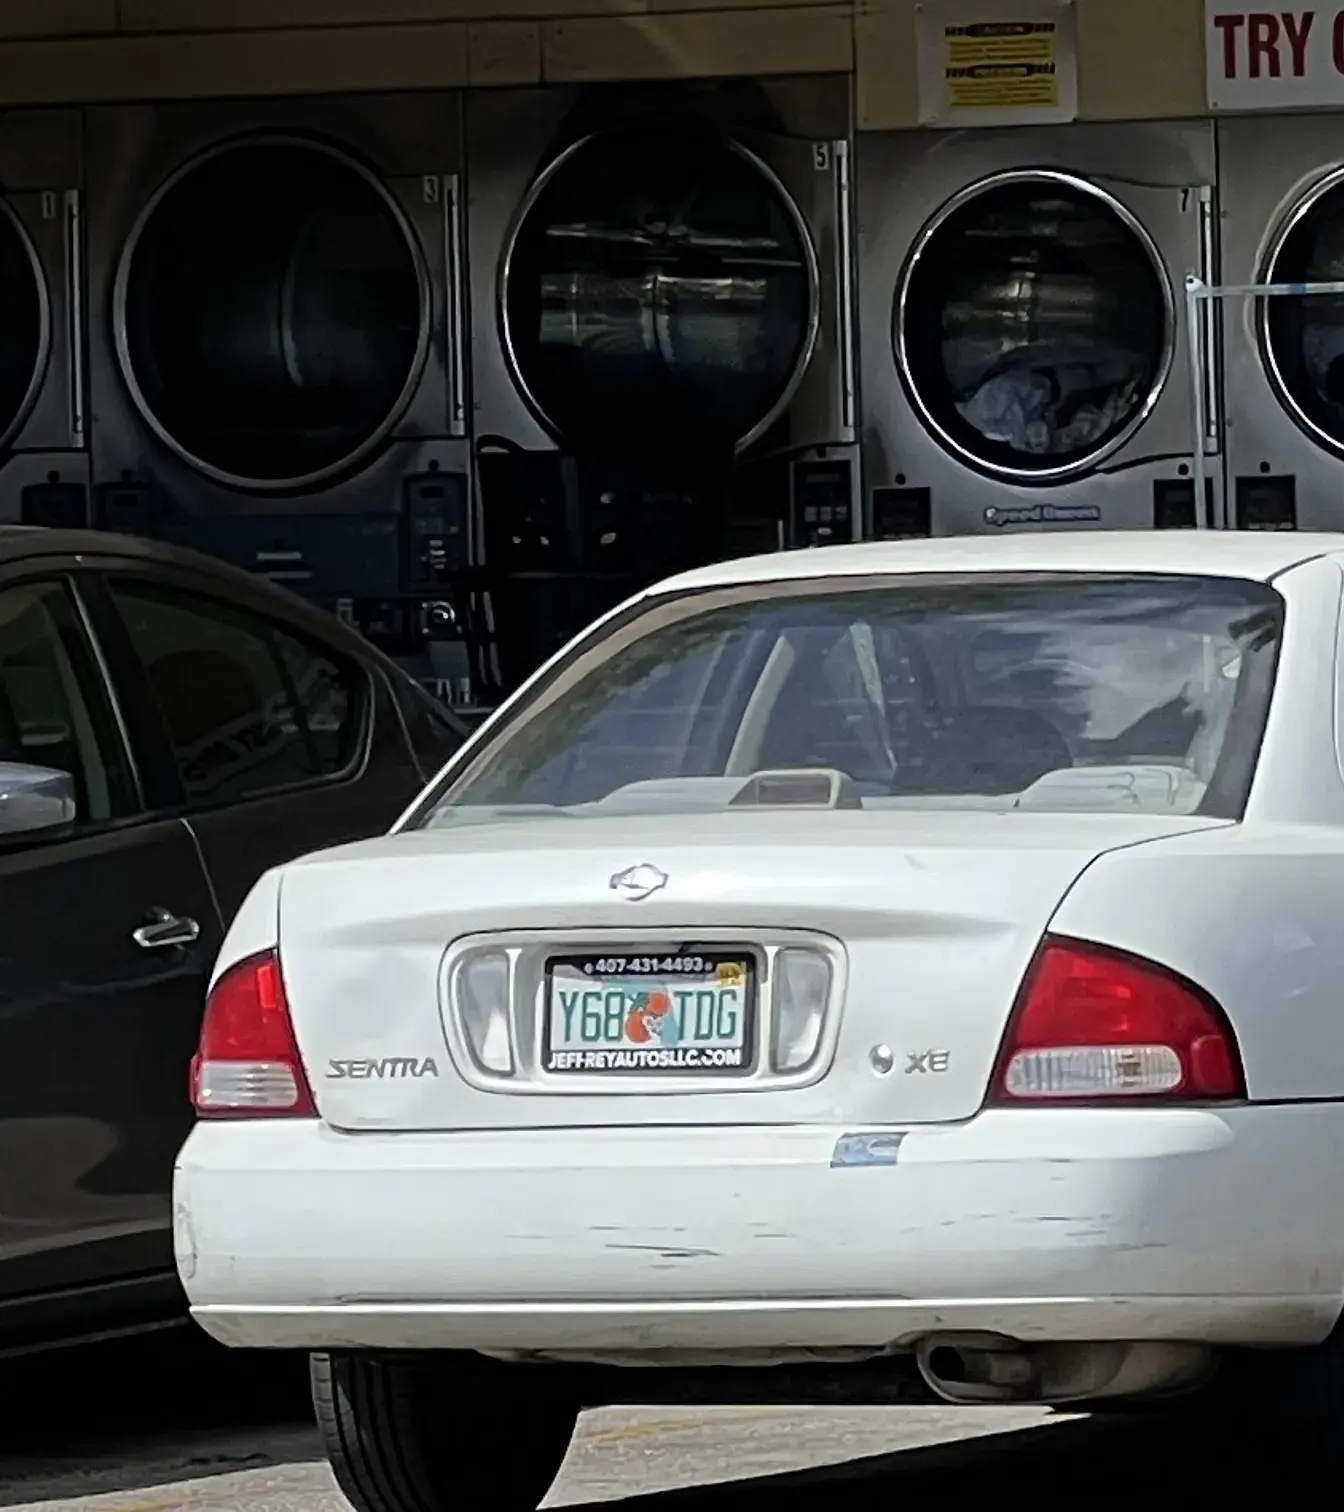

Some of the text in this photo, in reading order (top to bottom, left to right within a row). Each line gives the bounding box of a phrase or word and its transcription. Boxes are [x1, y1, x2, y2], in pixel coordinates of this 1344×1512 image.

[1213, 11, 1315, 80] TRY
[815, 144, 828, 169] 5
[1180, 188, 1192, 212] 7
[325, 1057, 439, 1078] SENTRA
[904, 1049, 950, 1074] XE
